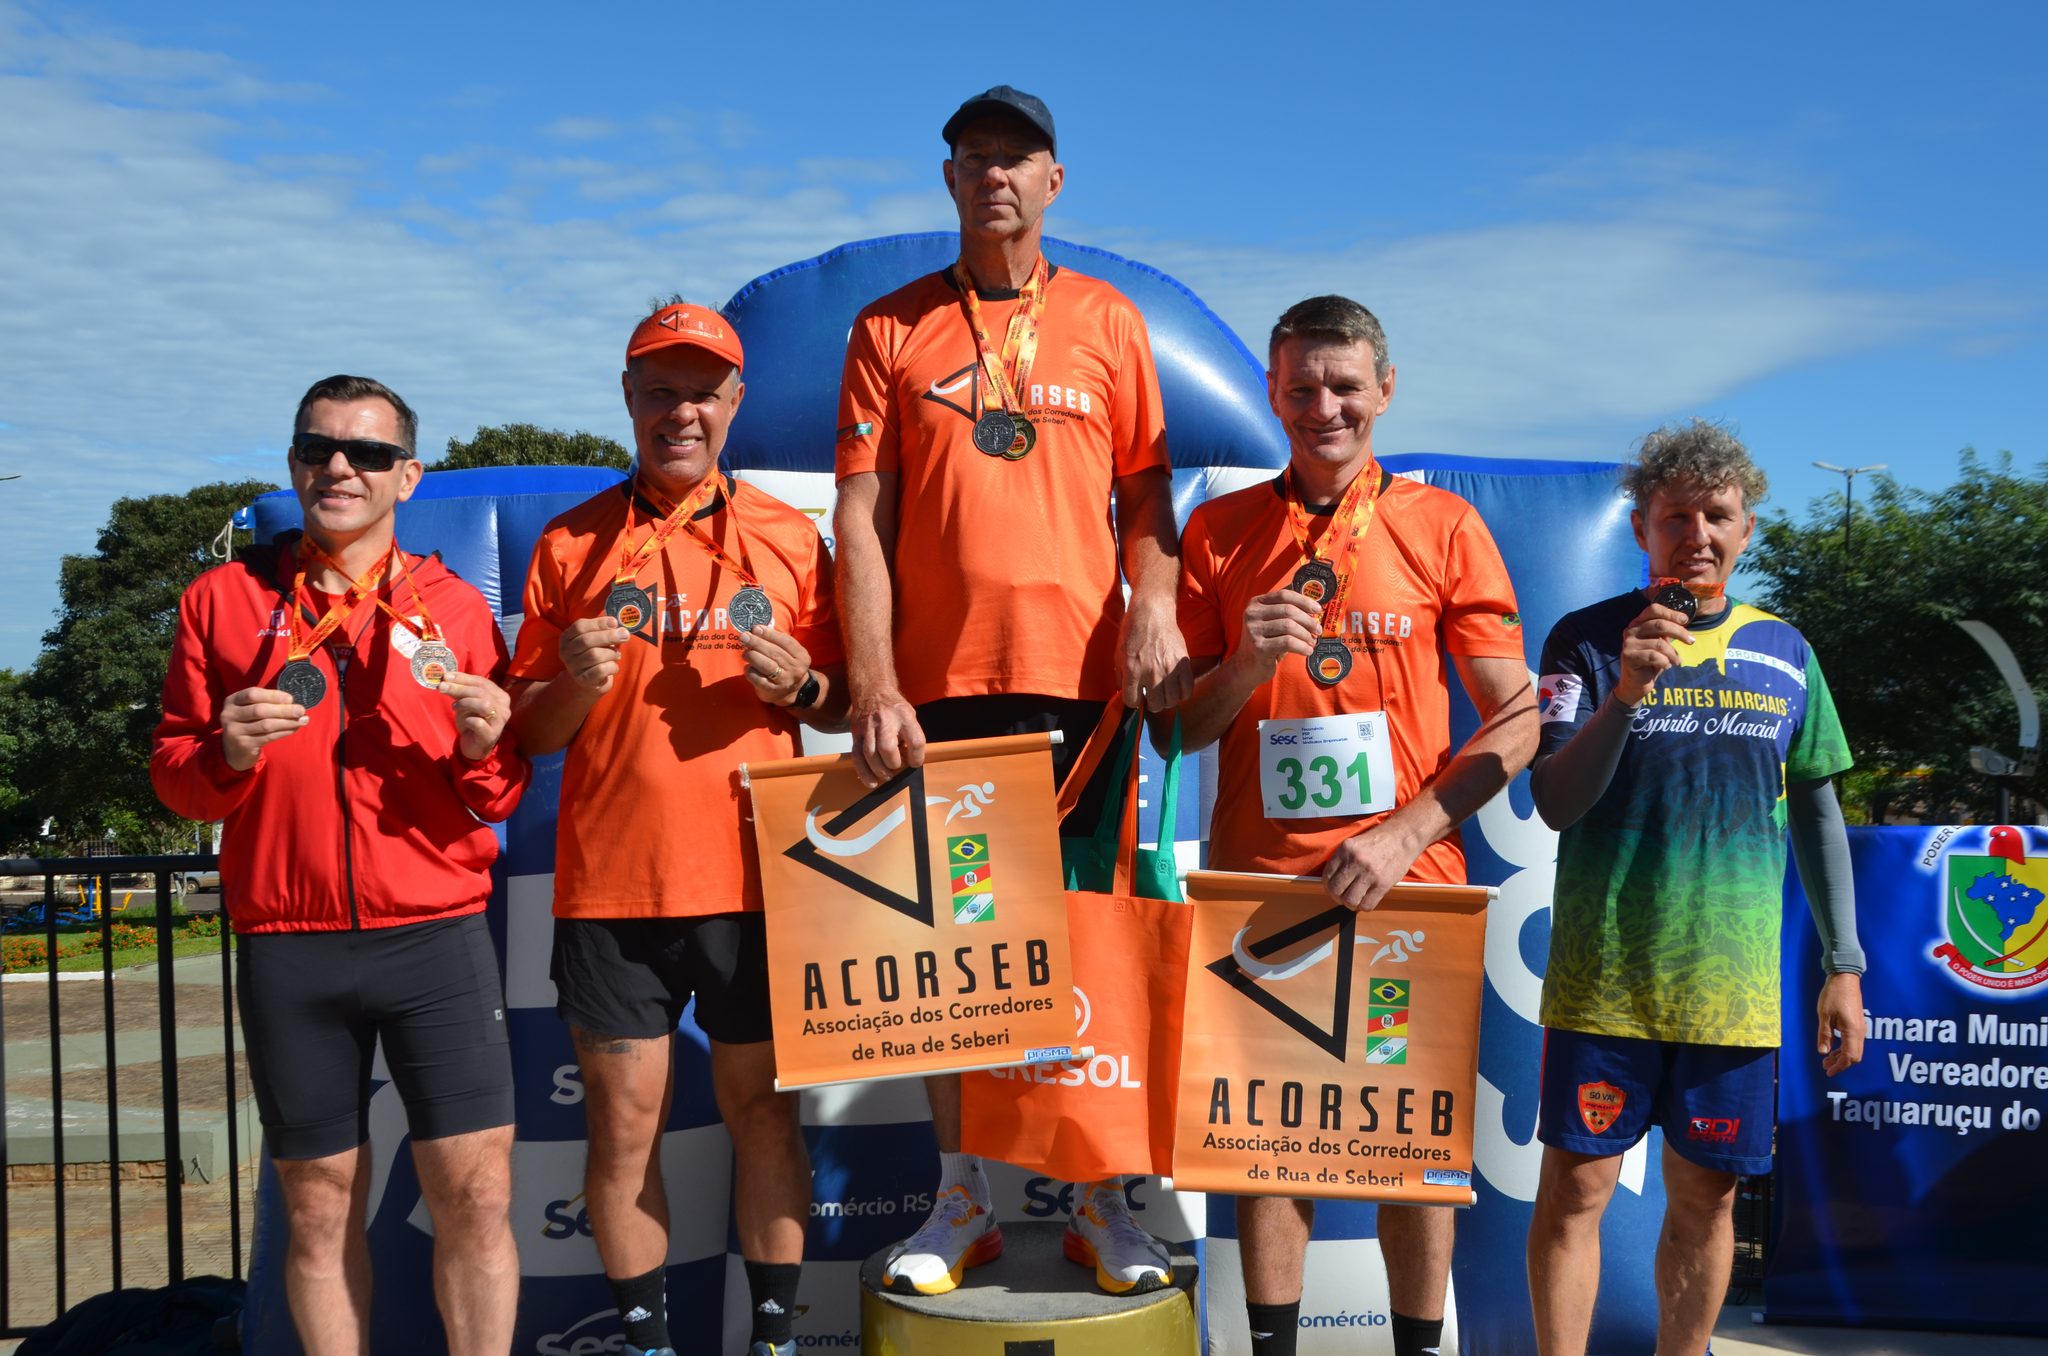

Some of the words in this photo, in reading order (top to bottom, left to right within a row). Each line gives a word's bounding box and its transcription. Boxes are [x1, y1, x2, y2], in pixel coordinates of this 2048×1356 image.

[1031, 384, 1090, 414] RSEB
[1341, 611, 1412, 638] RSEB
[725, 642, 745, 650] Sebe
[1727, 649, 1766, 663] ORDEM
[1663, 687, 1715, 708] ARTES
[1719, 689, 1788, 717] MARCIAIS
[1631, 708, 1699, 740] Espírito
[1704, 711, 1782, 740] Marcial
[1276, 751, 1372, 810] 331
[1923, 827, 1954, 866] PODER
[804, 938, 1051, 1011] ACORSEB
[802, 1010, 904, 1036] Associação
[910, 1006, 943, 1025] dos
[949, 996, 1054, 1020] Corredores
[1834, 1008, 1957, 1044] âmara
[852, 1043, 875, 1061] de
[882, 1041, 916, 1058] Rua
[921, 1035, 945, 1053] de
[951, 1028, 1010, 1050] Seberi
[1208, 1077, 1454, 1137] ACORSEB
[1827, 1092, 1992, 1136] Taquaruçu
[2001, 1095, 2041, 1132] do
[1203, 1132, 1301, 1157] Associação
[1308, 1137, 1341, 1156] dos
[1347, 1139, 1451, 1161] Corredores
[1247, 1164, 1270, 1180] de
[1277, 1166, 1310, 1183] Rua
[1316, 1167, 1339, 1183] de
[1346, 1169, 1403, 1187] Seberi
[809, 1197, 896, 1217] omércio
[1299, 1310, 1387, 1328] omércio
